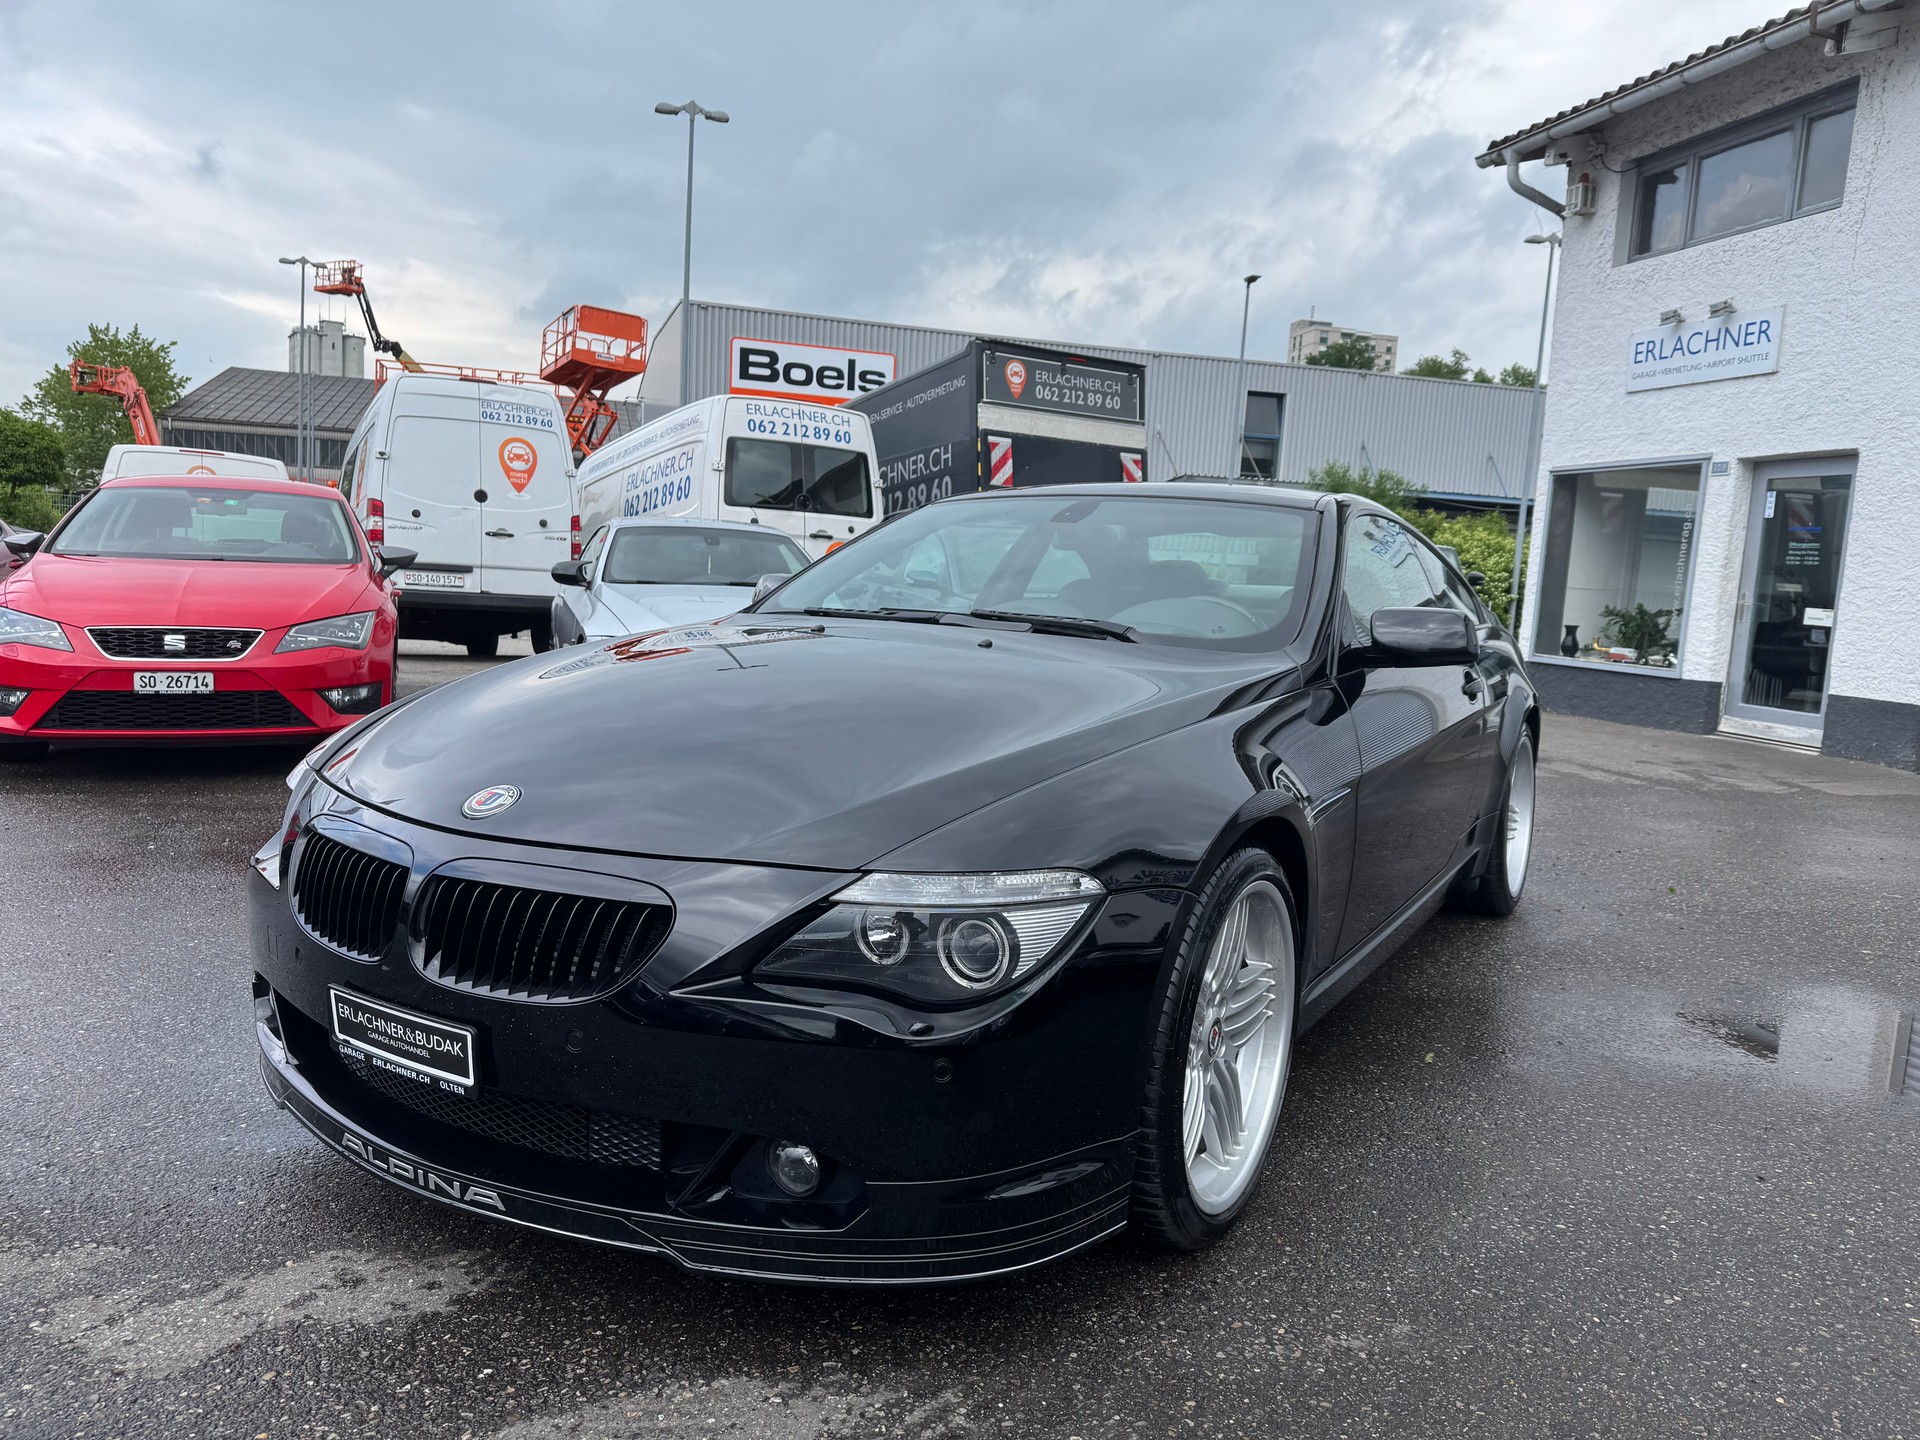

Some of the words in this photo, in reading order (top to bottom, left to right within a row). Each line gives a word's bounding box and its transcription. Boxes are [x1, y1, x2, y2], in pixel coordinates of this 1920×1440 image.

[1633, 320, 1772, 364] ERLACHNER
[739, 346, 886, 392] Boels
[1632, 369, 1657, 380] GARAGE
[1661, 363, 1702, 376] VERMIETUNG
[1706, 357, 1736, 369] AIRPORT
[1737, 352, 1770, 365] SHUTTLE
[906, 375, 966, 410] AUTOVERMIETUNG
[1035, 370, 1121, 394] ERLACHNER.CH
[1035, 385, 1059, 401] 062
[1062, 388, 1085, 405] 212
[1087, 392, 1102, 407] 89
[1105, 395, 1121, 409] 60
[481, 401, 553, 418] ERLACHNER.CH
[481, 410, 501, 421] 062
[505, 413, 523, 424] 212
[525, 416, 538, 426] 89
[540, 419, 553, 428] 60
[746, 403, 850, 428] ERLACHNER.CH
[747, 418, 777, 434] 062
[782, 421, 810, 438] 212
[813, 426, 831, 441] 89
[834, 429, 851, 444] 60
[626, 448, 695, 493] ERLACHNER.CH
[624, 494, 640, 517] 062
[642, 487, 659, 514] 212
[661, 481, 675, 507] 89
[676, 475, 691, 502] 60
[338, 1003, 464, 1058] ERLACHNER&BUDAK
[367, 1030, 390, 1045] GARAGE
[390, 1039, 431, 1058] AUTOHANDEL
[338, 1044, 366, 1061] GARAGE
[372, 1057, 430, 1084] ERLACHNER.CH
[439, 1080, 465, 1095] OLTEN
[341, 1132, 507, 1212] ALPINA
